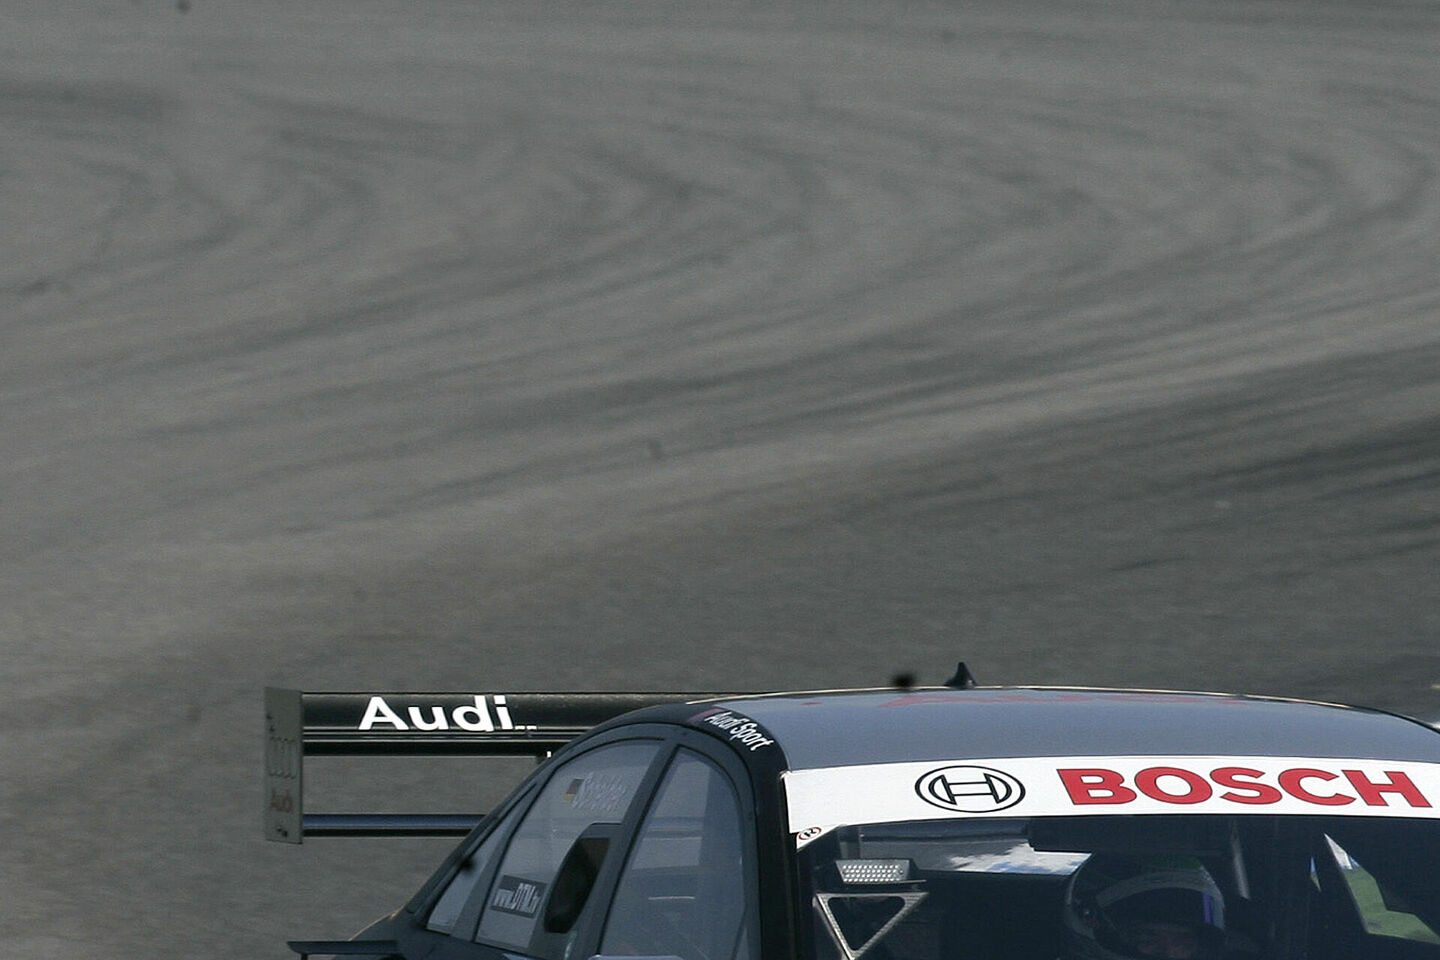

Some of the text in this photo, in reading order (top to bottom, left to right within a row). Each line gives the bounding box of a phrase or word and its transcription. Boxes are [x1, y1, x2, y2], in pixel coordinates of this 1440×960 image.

[358, 695, 514, 732] Audi
[730, 722, 775, 751] Sport
[1056, 768, 1433, 808] BOSCH
